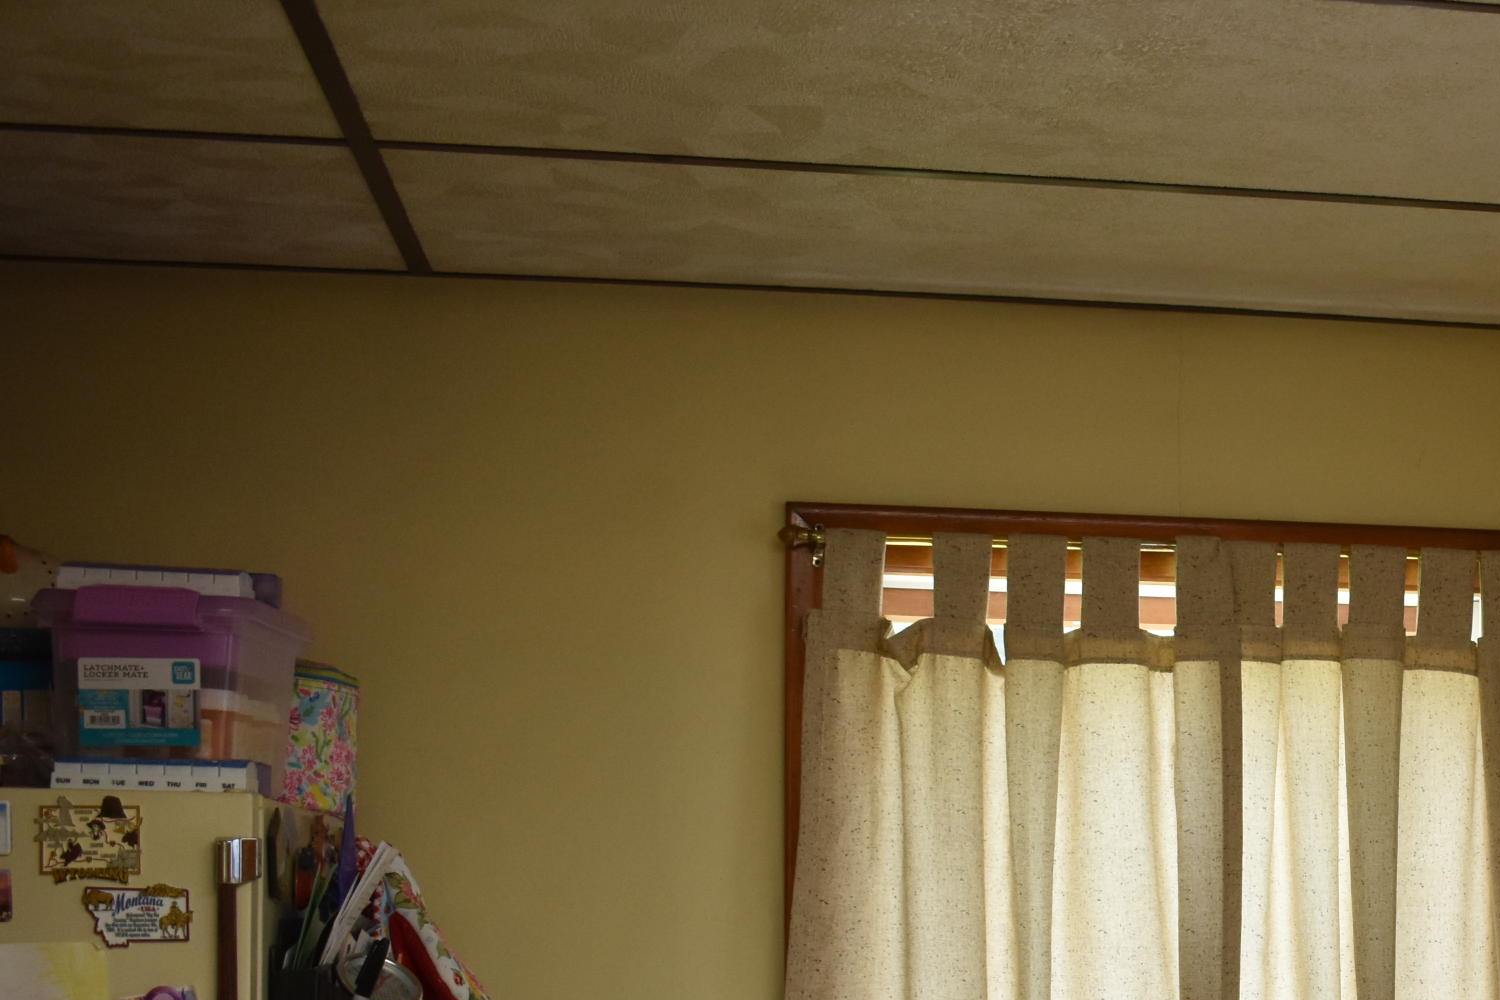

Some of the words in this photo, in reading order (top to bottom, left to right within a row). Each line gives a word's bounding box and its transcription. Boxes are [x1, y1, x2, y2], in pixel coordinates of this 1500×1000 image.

[83, 671, 120, 679] LOCKER
[122, 671, 149, 679] MATE
[114, 892, 164, 914] Montana
